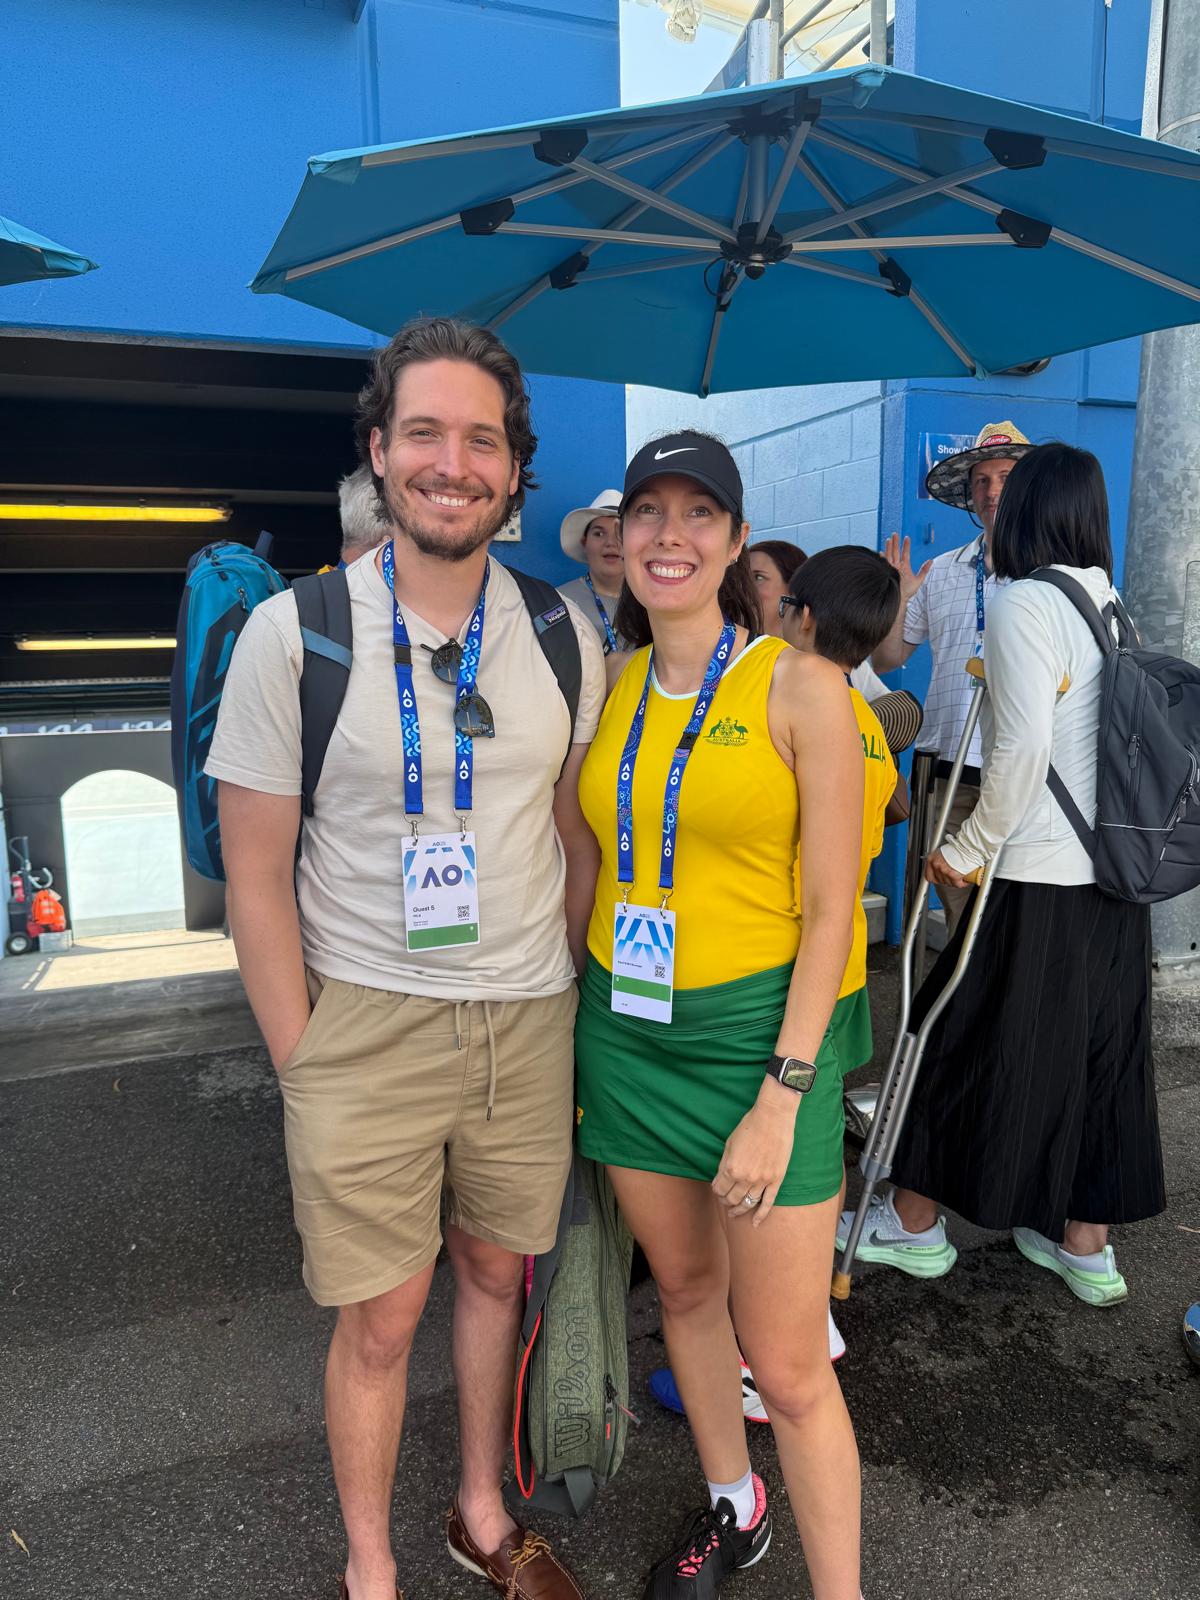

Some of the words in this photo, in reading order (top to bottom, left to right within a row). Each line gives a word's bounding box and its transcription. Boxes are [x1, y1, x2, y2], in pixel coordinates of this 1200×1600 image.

[937, 444, 961, 454] Show
[471, 615, 481, 632] AO
[717, 643, 729, 660] AO
[402, 688, 414, 709] AO
[638, 699, 646, 716] AO
[695, 700, 707, 716] AO
[408, 762, 419, 783] AO
[459, 759, 469, 780] AO
[620, 762, 631, 781] AO
[670, 766, 680, 786] AO
[620, 832, 630, 851] AO
[663, 837, 672, 858] AO
[420, 864, 464, 889] AO
[412, 905, 430, 913] Guest
[553, 1304, 592, 1458] Wilson
